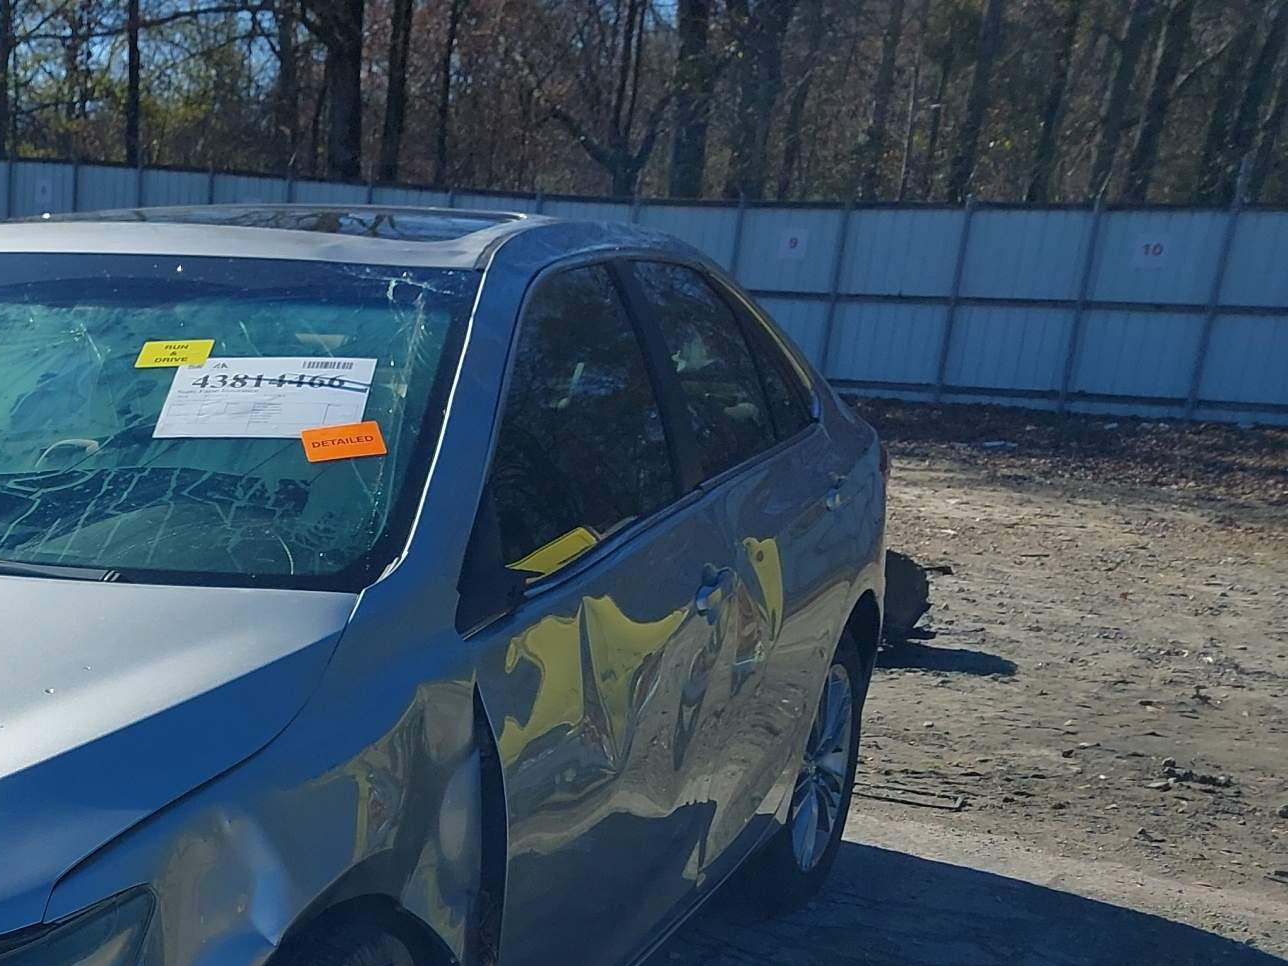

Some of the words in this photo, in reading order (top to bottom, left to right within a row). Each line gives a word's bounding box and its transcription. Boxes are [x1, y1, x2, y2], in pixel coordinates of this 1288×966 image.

[788, 236, 799, 249] 9
[1143, 243, 1163, 257] 10
[192, 373, 345, 389] 43814466
[311, 435, 374, 449] DETAILED
